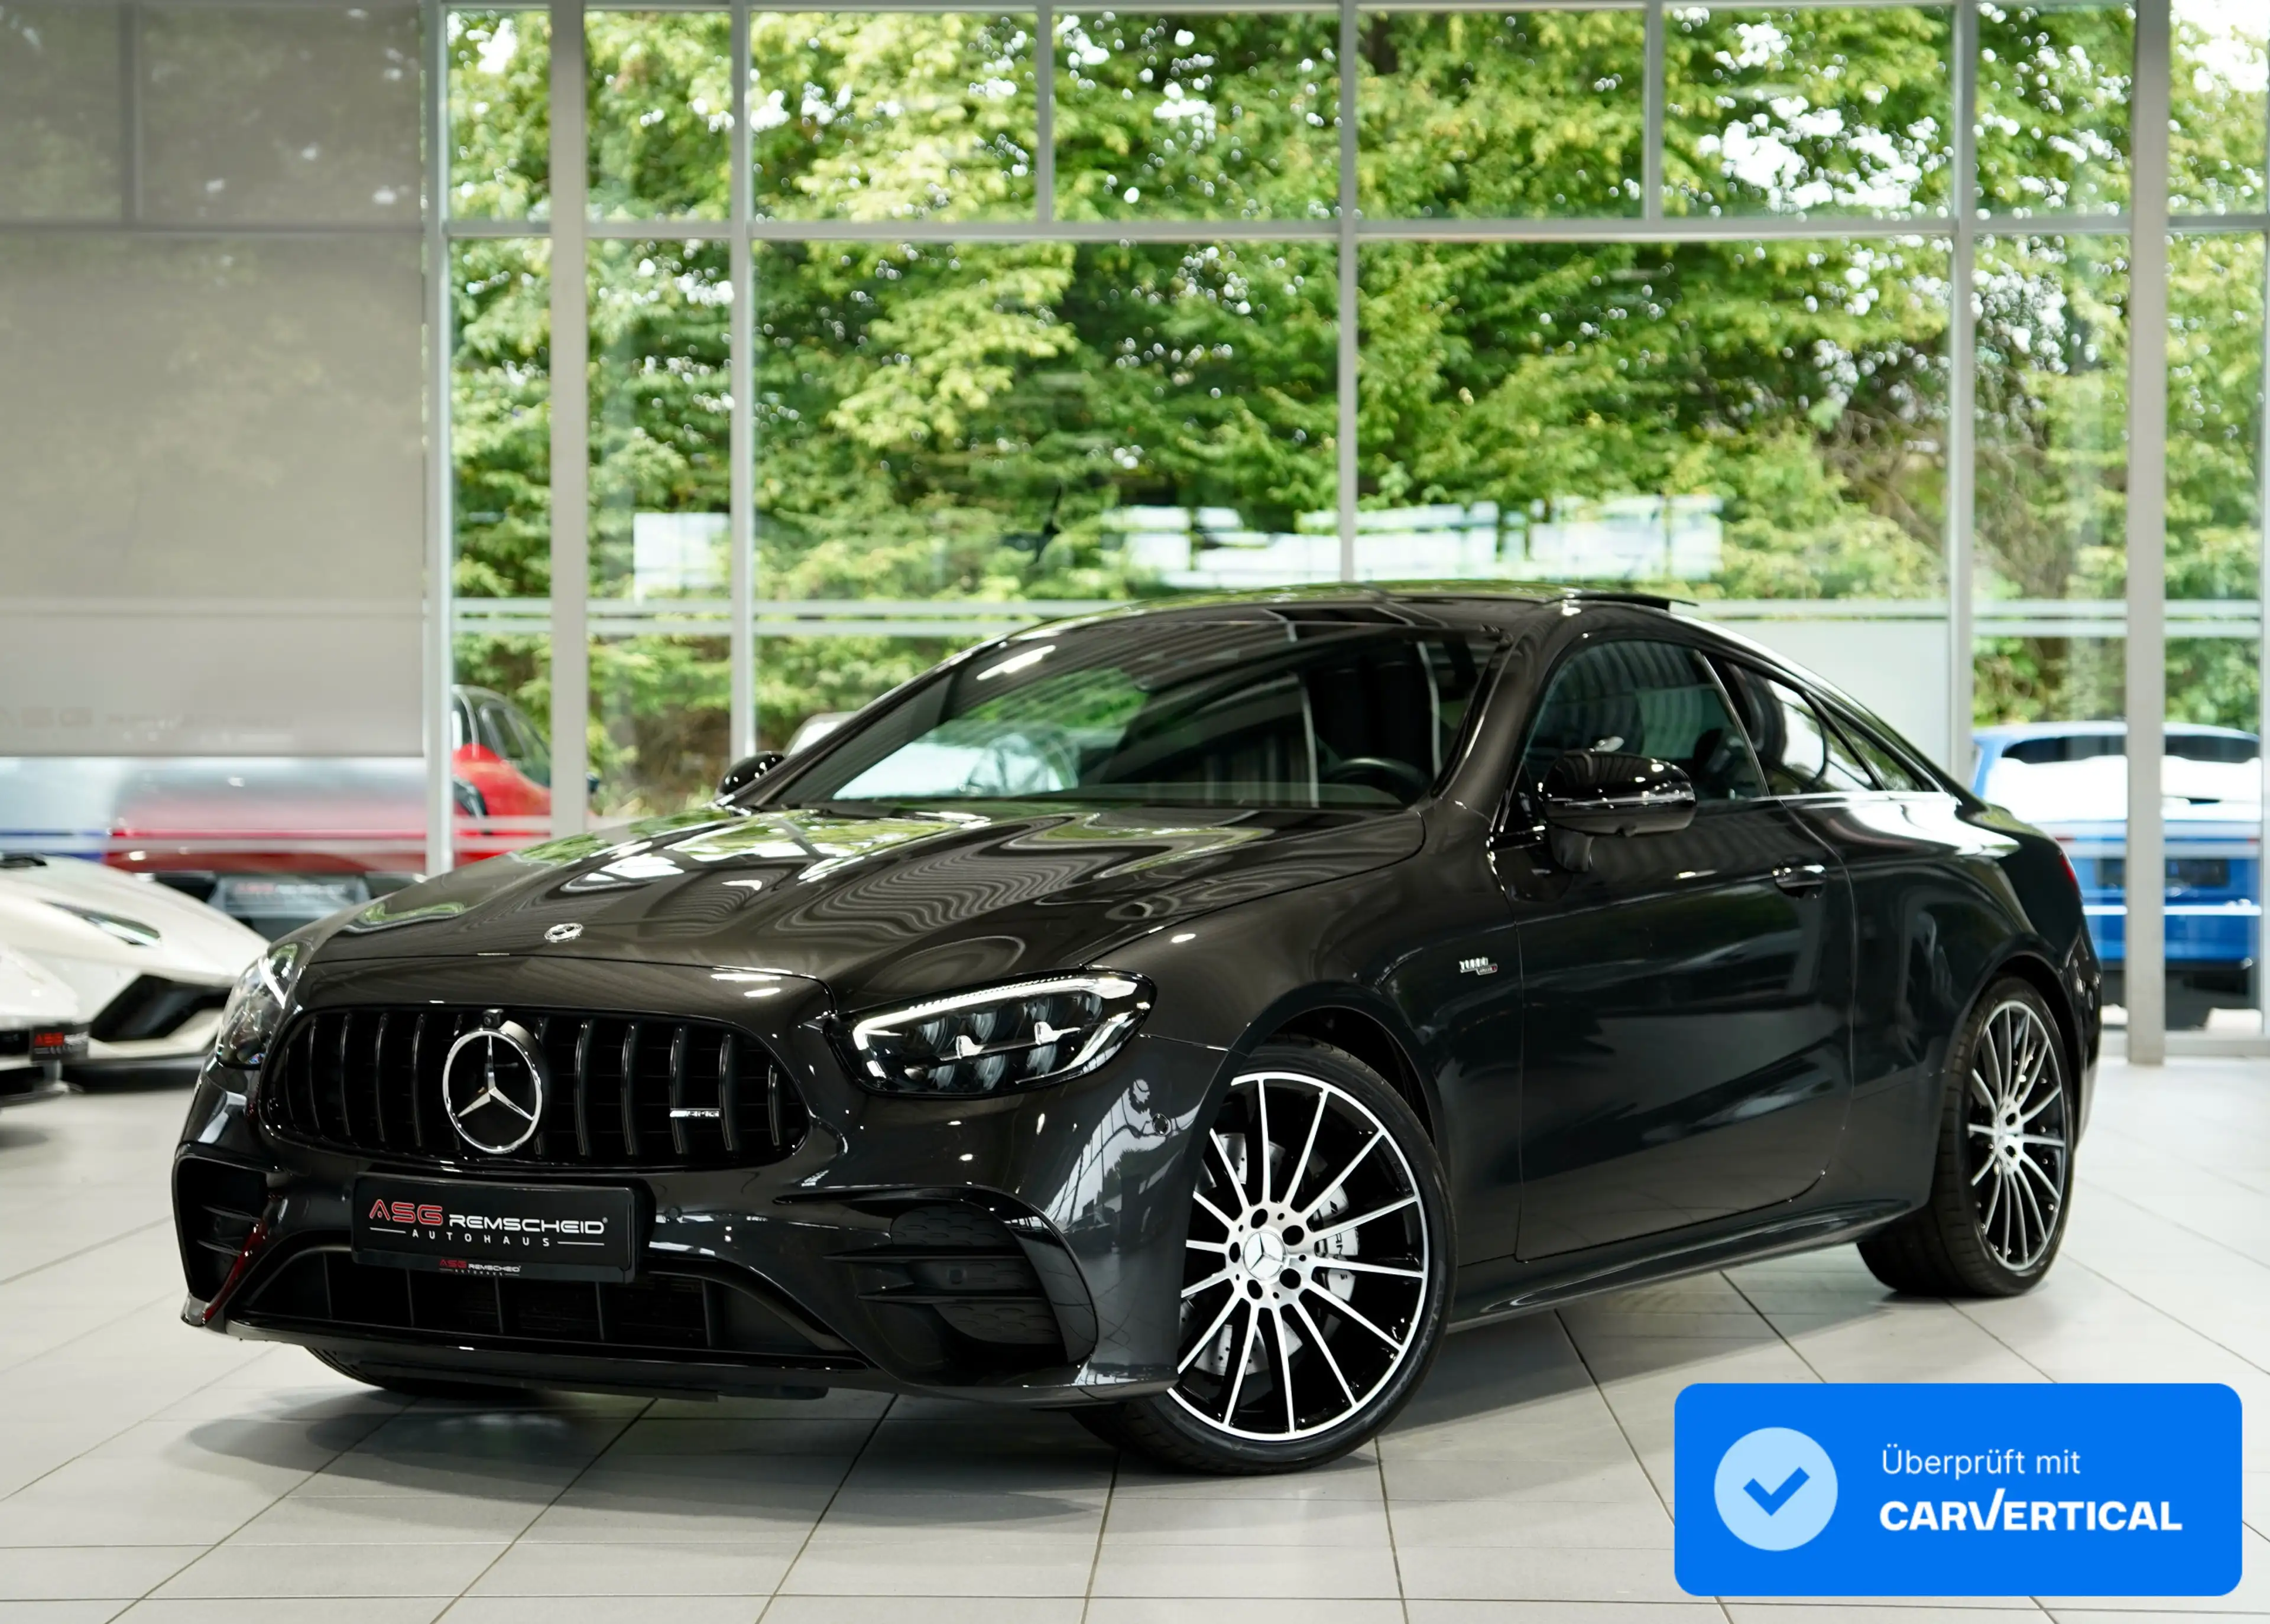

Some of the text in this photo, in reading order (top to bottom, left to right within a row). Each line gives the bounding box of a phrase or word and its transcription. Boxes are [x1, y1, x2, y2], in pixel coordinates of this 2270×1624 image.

[369, 1198, 444, 1226] ASG
[411, 1229, 551, 1248] AUTOHAUS
[439, 1258, 468, 1269] ASG
